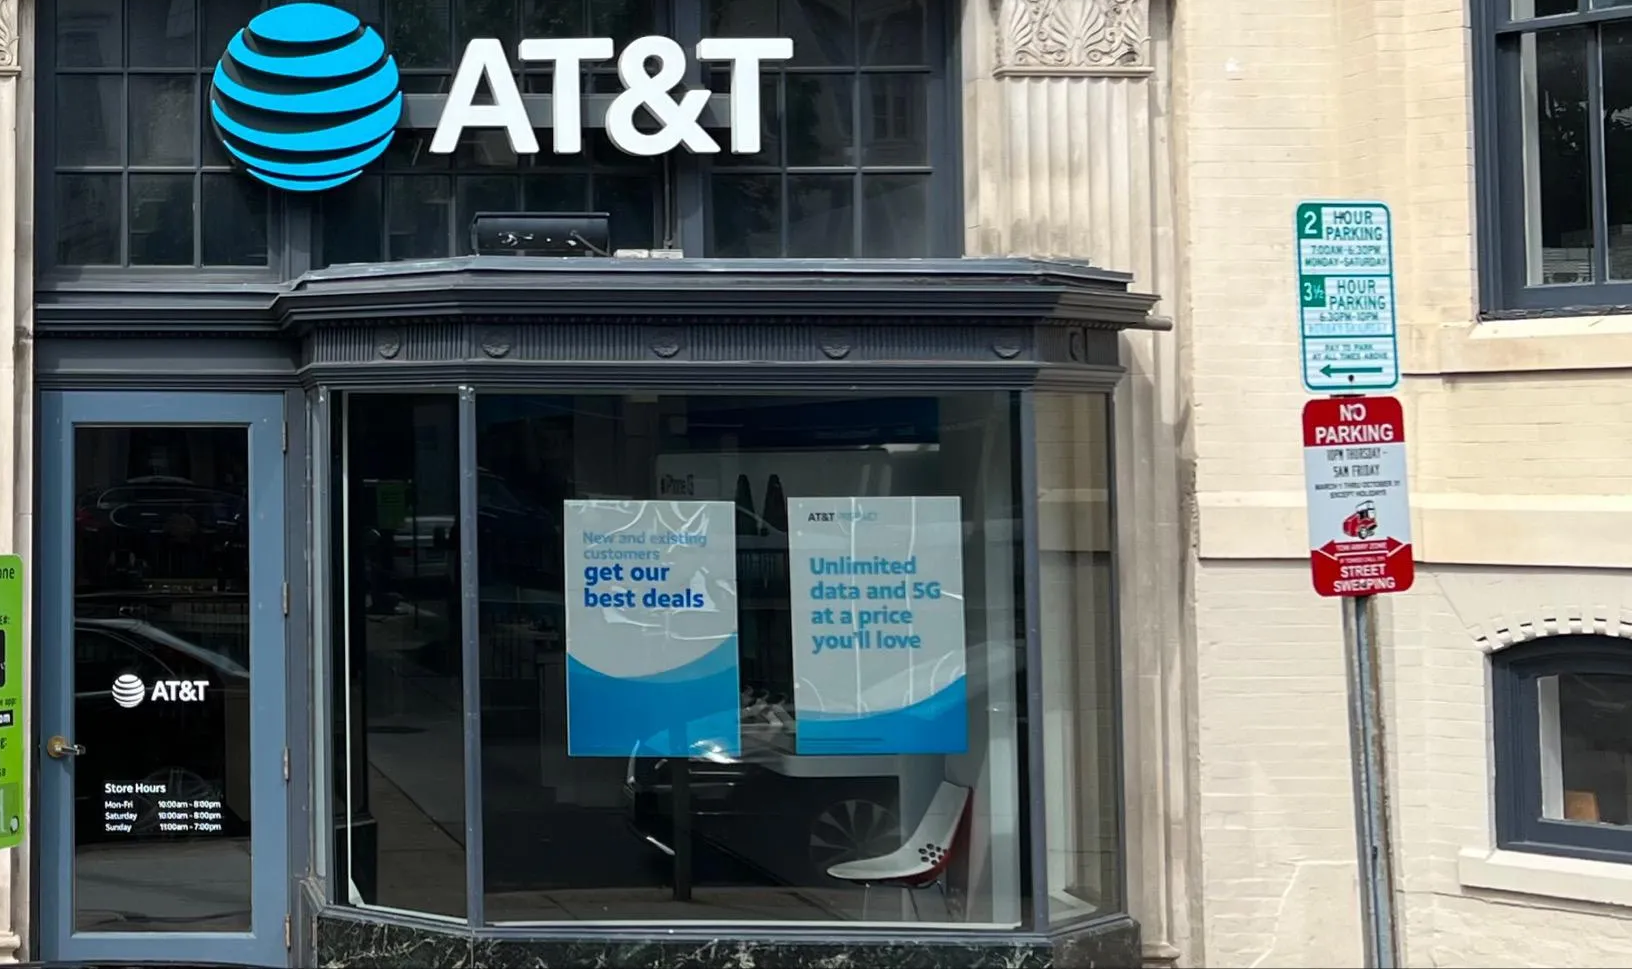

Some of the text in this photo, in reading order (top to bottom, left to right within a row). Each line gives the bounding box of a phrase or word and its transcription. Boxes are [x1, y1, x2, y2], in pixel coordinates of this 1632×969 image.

[428, 35, 794, 157] AT&T
[1304, 210, 1374, 234] 2 HOUR
[1326, 226, 1383, 240] PARKING
[1337, 279, 1376, 294] HOUR
[1329, 296, 1386, 310] PARKING
[1339, 403, 1367, 422] NO
[1315, 423, 1394, 444] PARKING
[1333, 464, 1380, 478] 5AM FRIDAY
[807, 512, 835, 522] AT&T
[582, 531, 707, 548] New and existing
[583, 549, 661, 561] customers
[809, 555, 916, 575] Unlimited
[1339, 563, 1387, 578] STREET
[584, 563, 670, 586] get our
[810, 580, 942, 600] data and 5G
[1333, 577, 1396, 592] SWEEPING
[584, 587, 704, 608] best deals
[811, 605, 913, 629] at a price
[811, 630, 921, 655] you'll love
[151, 680, 209, 702] AT&T
[104, 783, 166, 793] Store Hours
[104, 800, 133, 809] Mon-Fri
[105, 812, 137, 821] Saturday
[105, 823, 132, 832] Sunday
